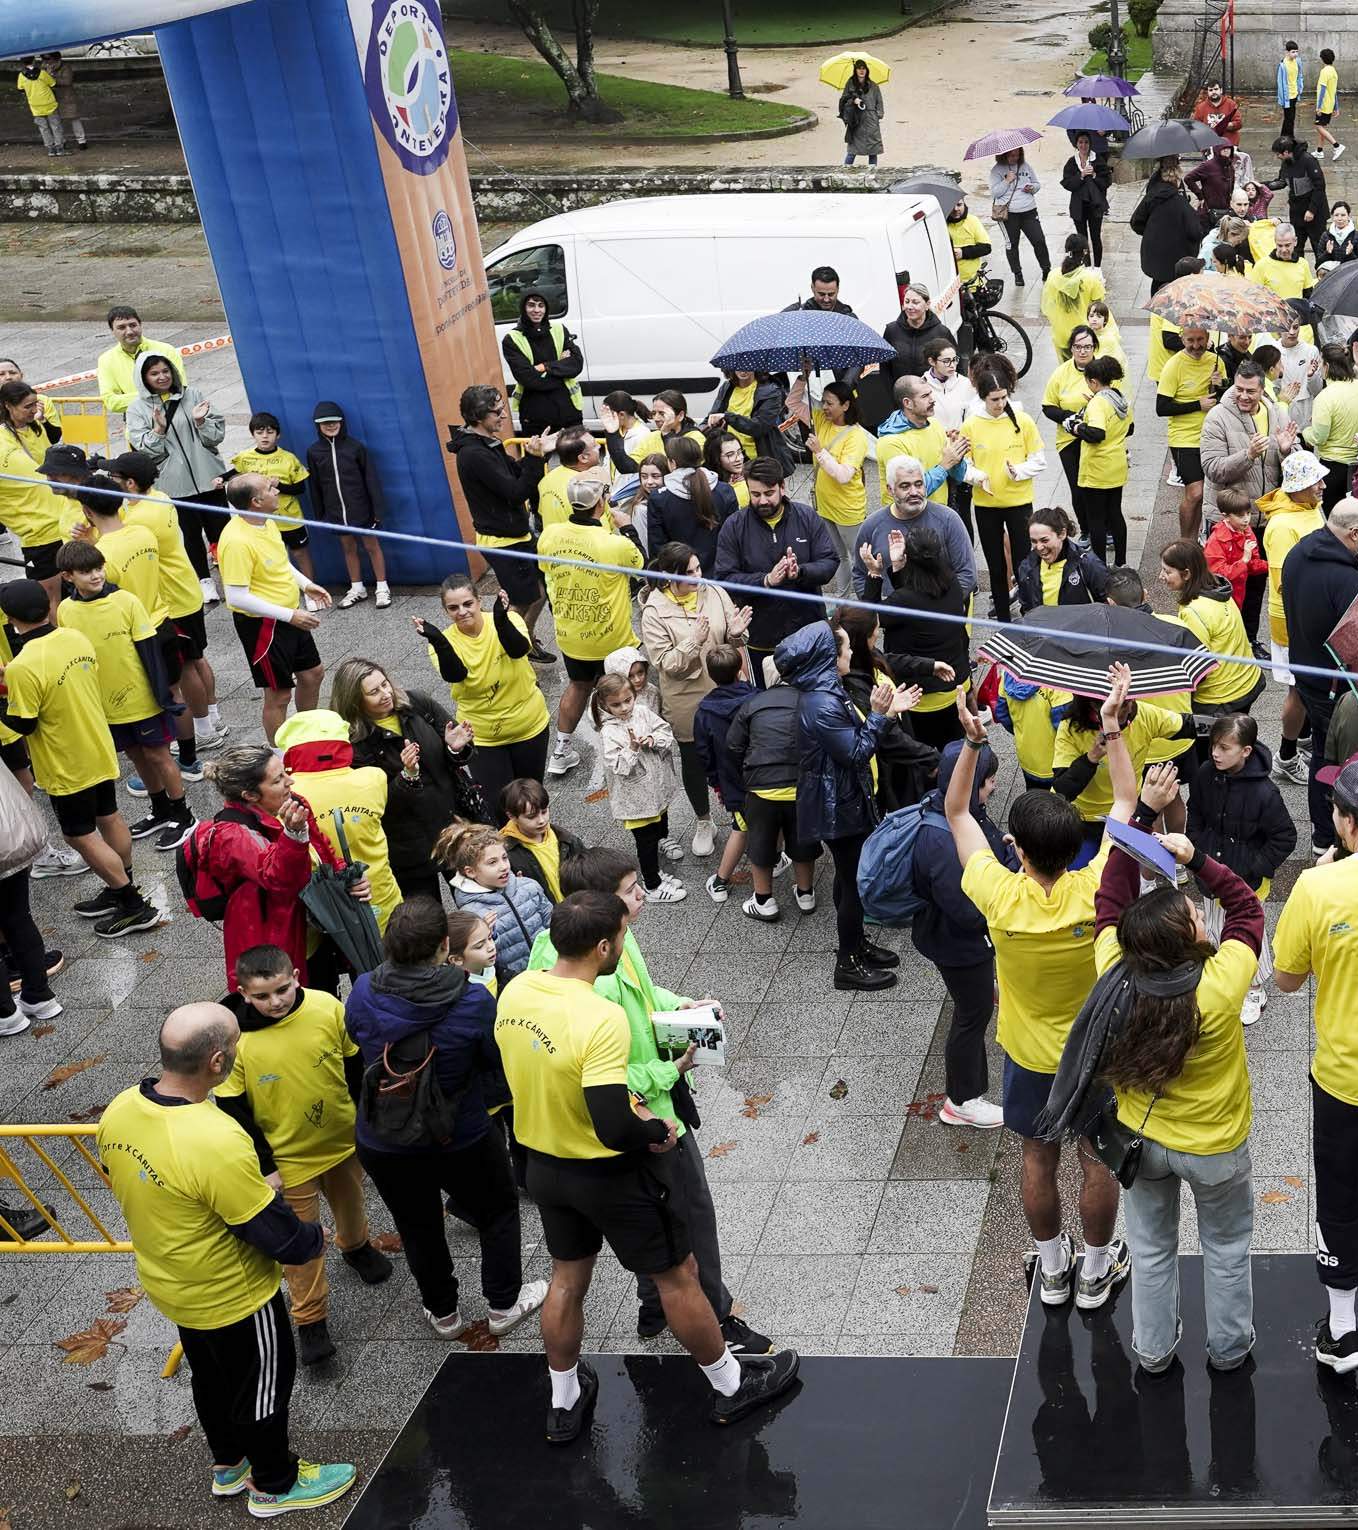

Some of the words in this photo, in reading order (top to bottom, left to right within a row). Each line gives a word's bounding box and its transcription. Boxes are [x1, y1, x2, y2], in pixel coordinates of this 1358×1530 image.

[518, 1018, 525, 1027] X
[125, 1144, 132, 1153] X
[132, 1148, 165, 1189] CÁRITAS
[252, 1495, 278, 1504] HOKA
